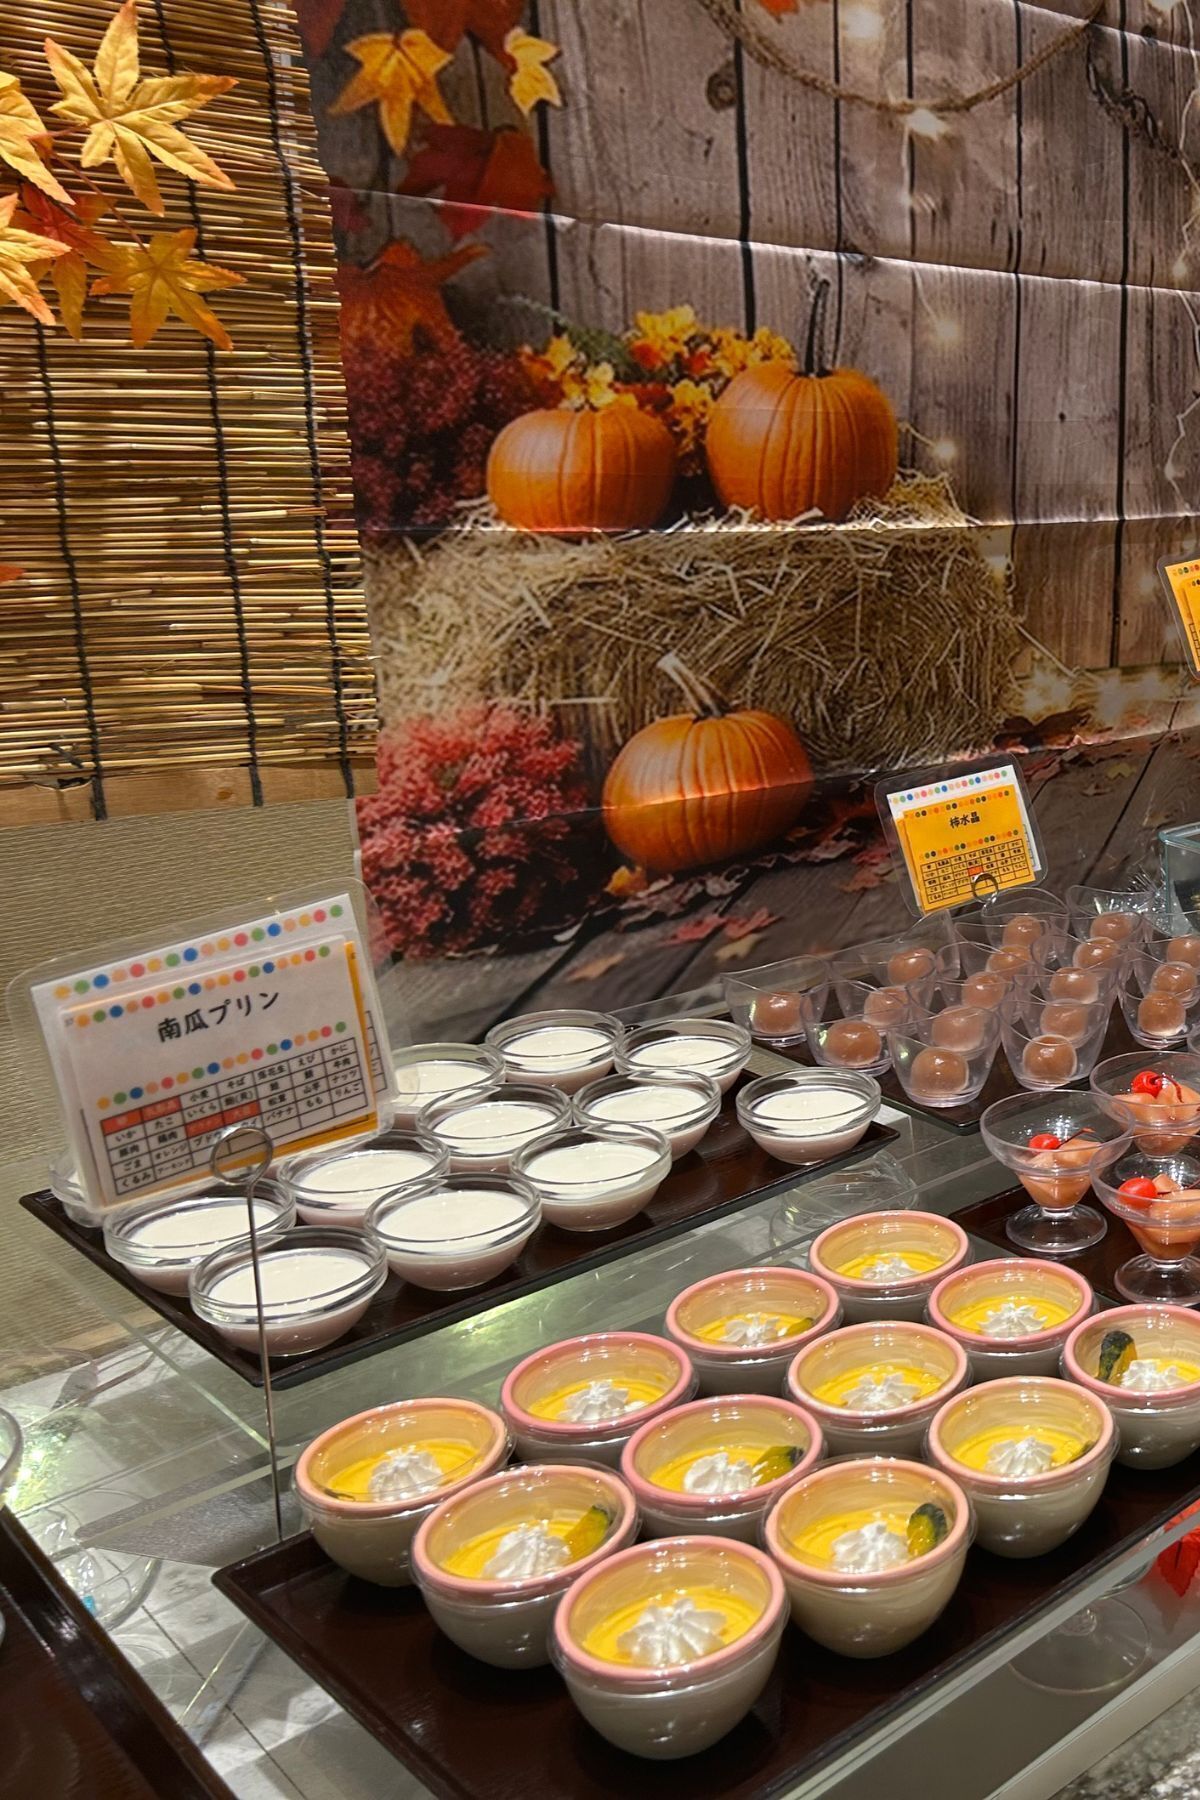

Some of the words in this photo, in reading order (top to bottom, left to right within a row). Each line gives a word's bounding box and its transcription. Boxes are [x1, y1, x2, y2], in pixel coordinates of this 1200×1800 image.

[158, 992, 279, 1042] 南瓜プリン
[226, 1076, 246, 1090] そば
[297, 1053, 316, 1066] えび
[330, 1043, 347, 1055] かに
[331, 1069, 357, 1084] ナッツ
[114, 1128, 136, 1142] いか
[154, 1116, 174, 1130] たこ
[187, 1102, 216, 1118] いくら
[123, 1158, 141, 1172] ごま
[154, 1142, 188, 1161] オレンジ
[265, 1105, 293, 1121] バナナ
[306, 1095, 322, 1107] もも
[334, 1082, 361, 1098] りんご
[122, 1171, 150, 1187] くるみ
